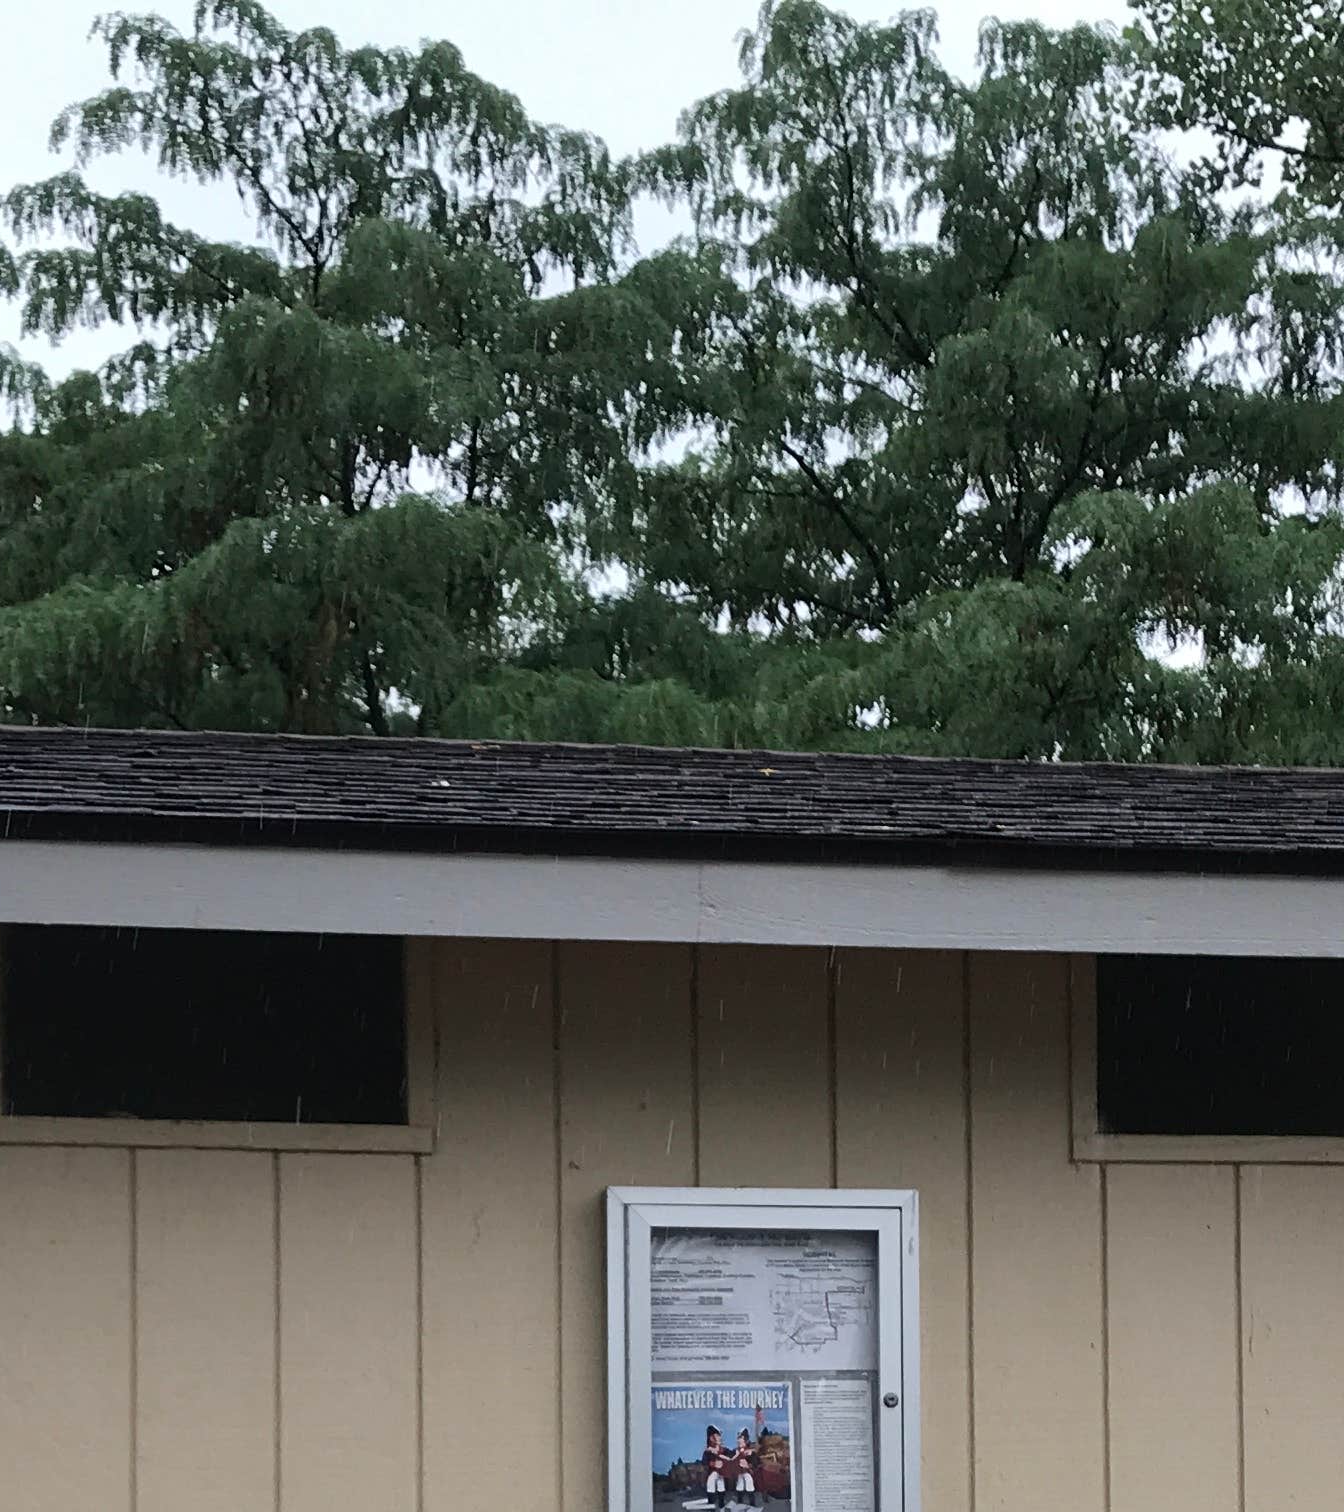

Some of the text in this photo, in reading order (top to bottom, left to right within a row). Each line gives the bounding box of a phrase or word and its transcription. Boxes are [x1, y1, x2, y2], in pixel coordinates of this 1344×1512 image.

[655, 1391, 714, 1409] WHATEVER
[716, 1390, 736, 1409] THE
[738, 1390, 784, 1409] JOURNEY
